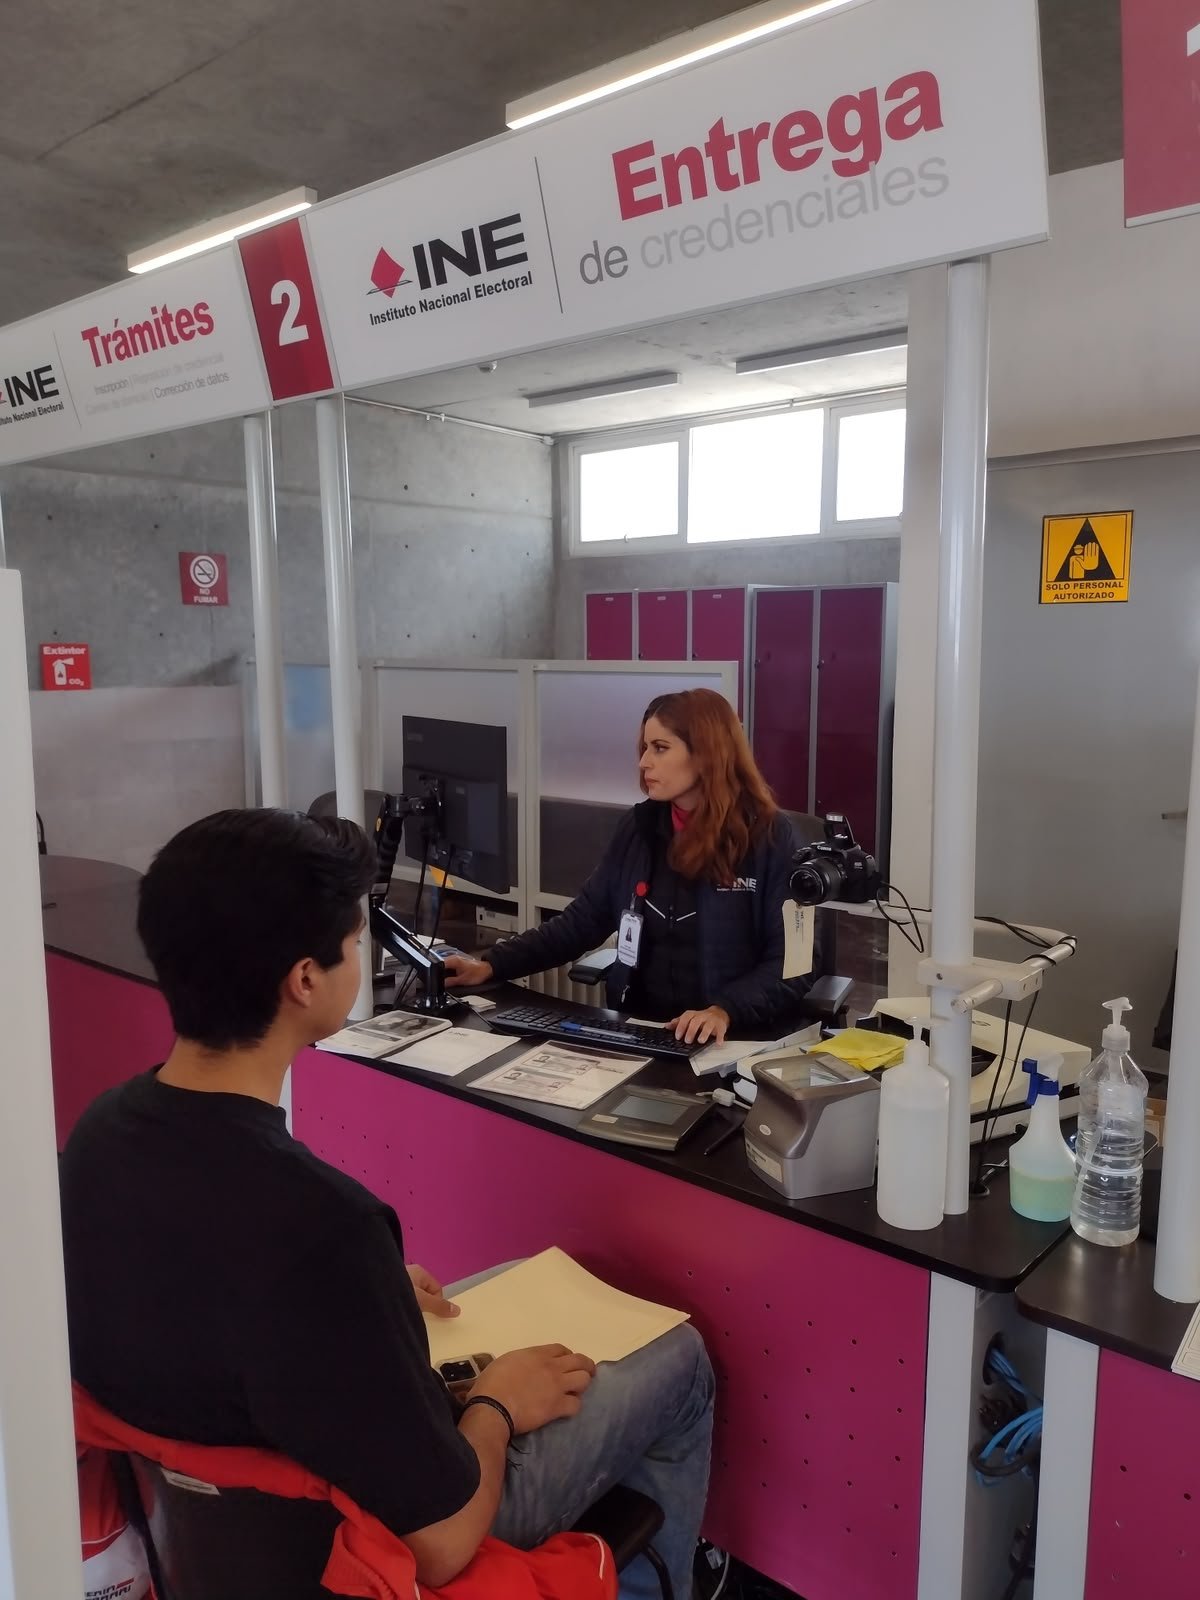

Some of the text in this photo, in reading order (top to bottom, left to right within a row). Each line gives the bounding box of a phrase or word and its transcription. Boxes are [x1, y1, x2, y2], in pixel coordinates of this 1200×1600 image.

[611, 70, 944, 221] Entrega
[579, 155, 950, 285] de credenciales
[412, 212, 529, 291] INE
[270, 280, 310, 347] 2
[369, 271, 533, 326] Instituto Nacional Electoral
[81, 302, 215, 368] Trámites
[4, 364, 60, 408] INE
[154, 371, 230, 399] Corrección de datos
[12, 408, 38, 423] Nacional
[37, 401, 65, 416] Electoral
[1046, 581, 1124, 591] SOLO PERSONAL
[1053, 591, 1115, 600] AUTORIZADO
[42, 646, 86, 655] Extintor
